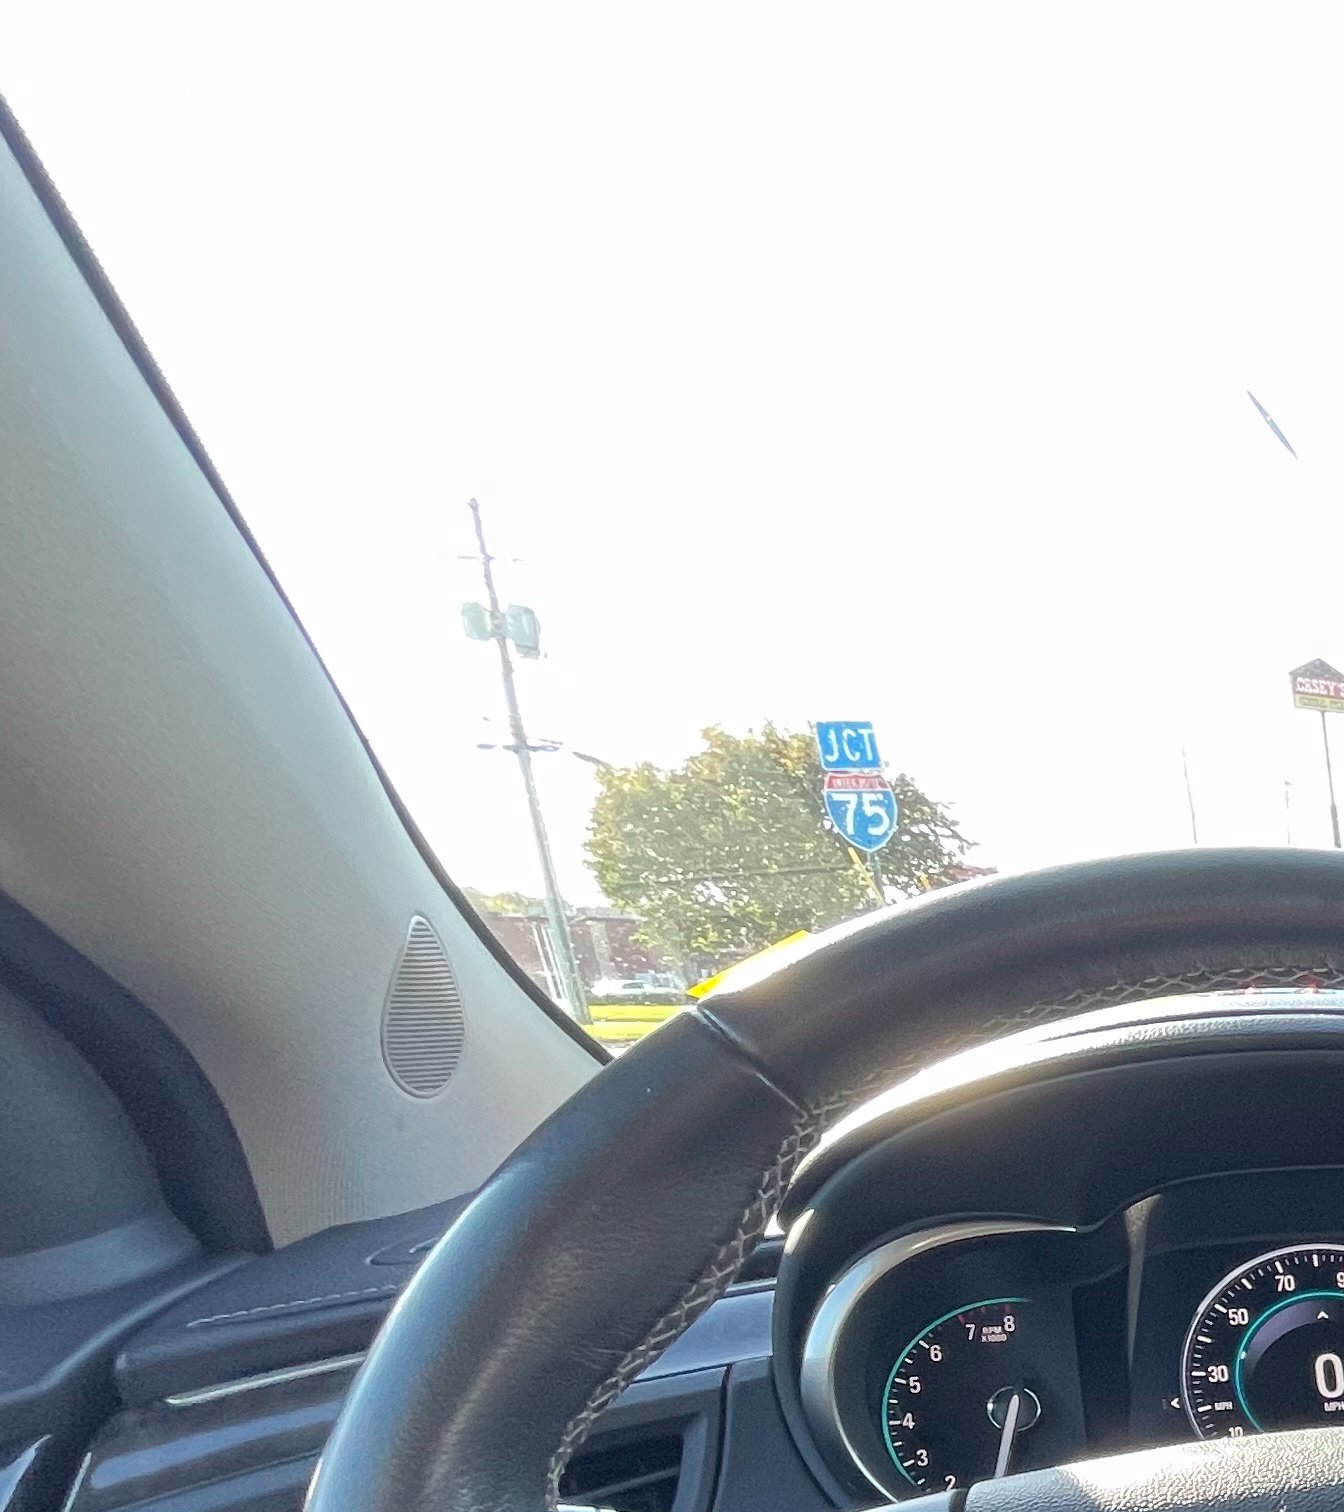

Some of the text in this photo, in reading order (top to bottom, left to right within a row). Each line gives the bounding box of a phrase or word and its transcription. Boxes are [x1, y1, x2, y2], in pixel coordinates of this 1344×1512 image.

[825, 729, 874, 762] JCT
[831, 793, 890, 836] 75
[1275, 1274, 1295, 1292] 70
[1003, 1315, 1016, 1332] 8
[1228, 1308, 1249, 1326] 50
[965, 1323, 976, 1341] 7
[930, 1345, 942, 1362] 6
[1207, 1365, 1229, 1383] 30
[908, 1376, 922, 1394] 5
[902, 1413, 916, 1430] 4
[916, 1449, 929, 1467] 3
[945, 1475, 956, 1491] 2
